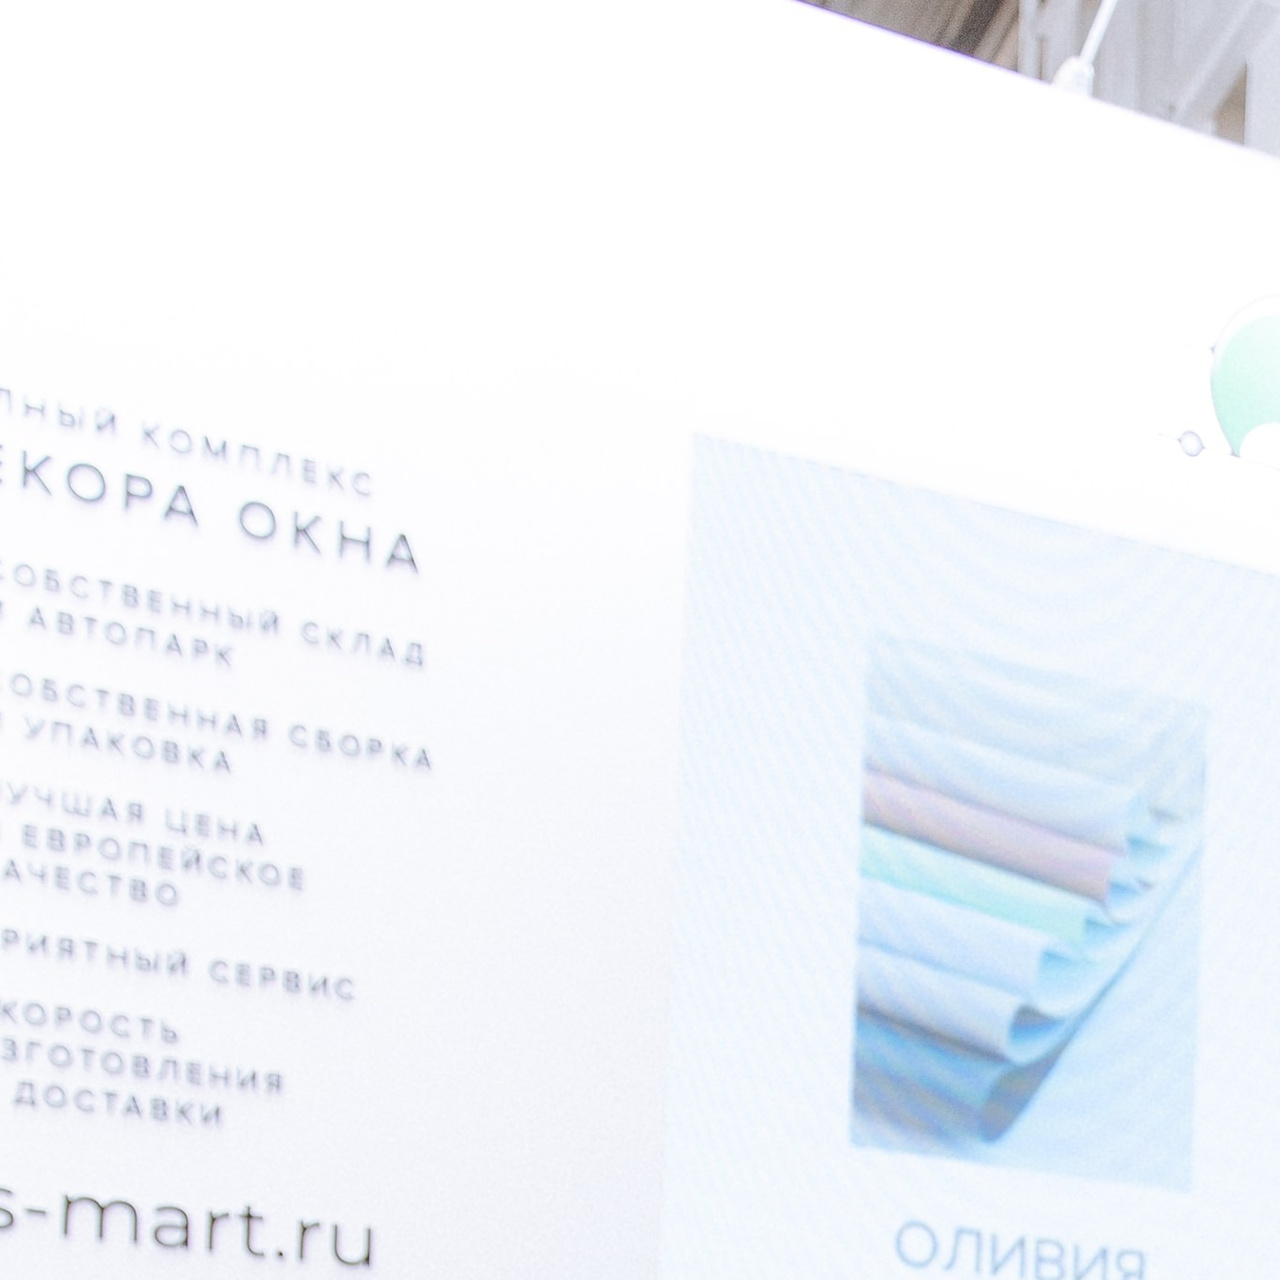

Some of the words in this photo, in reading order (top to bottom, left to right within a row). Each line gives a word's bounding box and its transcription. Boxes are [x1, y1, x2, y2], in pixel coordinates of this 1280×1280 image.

[141, 423, 372, 499] КОМПЛЕКС
[0, 444, 199, 531] КОРА
[237, 500, 420, 576] ОКНА
[0, 560, 281, 636] ОБСТВЕННЫЙ
[300, 620, 425, 671] СКЛАД
[27, 606, 234, 669] АВТОПАРК
[25, 714, 232, 774] УПАКОВКА
[288, 723, 433, 773] СБОРКА
[165, 809, 265, 847] ЦЕНА
[22, 823, 305, 895] ЕВРОПЕЙСКОЕ
[208, 959, 356, 1004] СЕРВИС
[12, 1080, 224, 1128] ДОСТАВКИ
